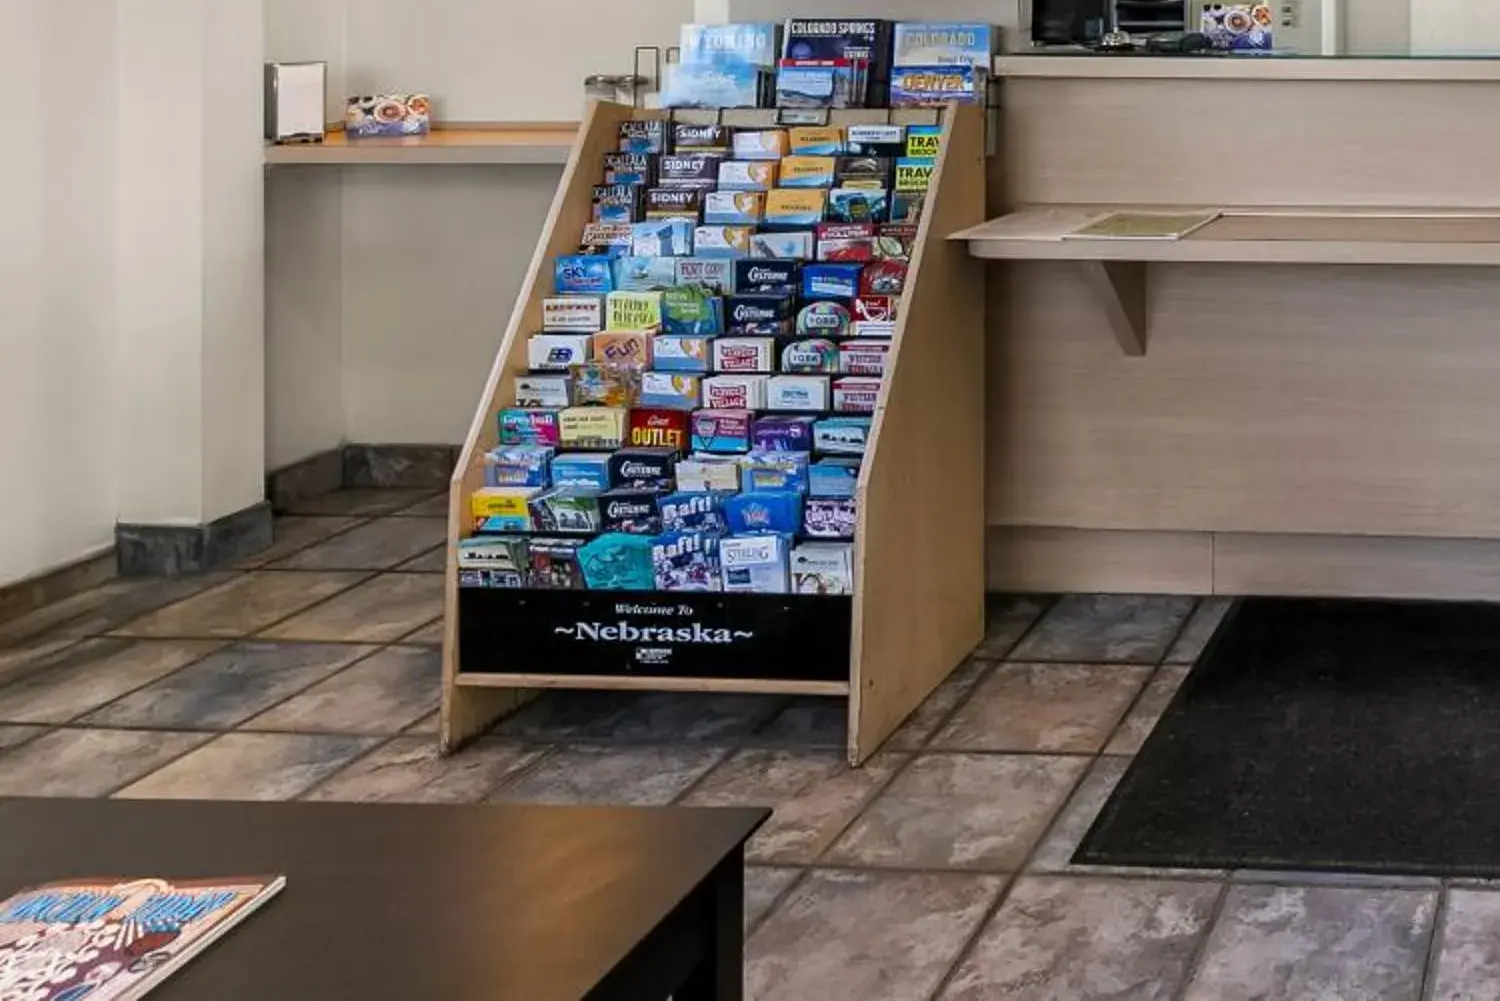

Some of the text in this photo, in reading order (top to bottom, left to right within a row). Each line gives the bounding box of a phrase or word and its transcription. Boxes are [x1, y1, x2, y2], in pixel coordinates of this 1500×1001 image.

[791, 21, 875, 34] COLORADO SPRINGS
[904, 31, 975, 47] COLORADO
[679, 128, 721, 139] SIDNEY
[663, 160, 705, 171] SIDNEY
[898, 167, 934, 178] TRAV
[651, 192, 694, 203] SIDNEY
[631, 427, 681, 447] OUTLET
[614, 603, 694, 617] Welcome To
